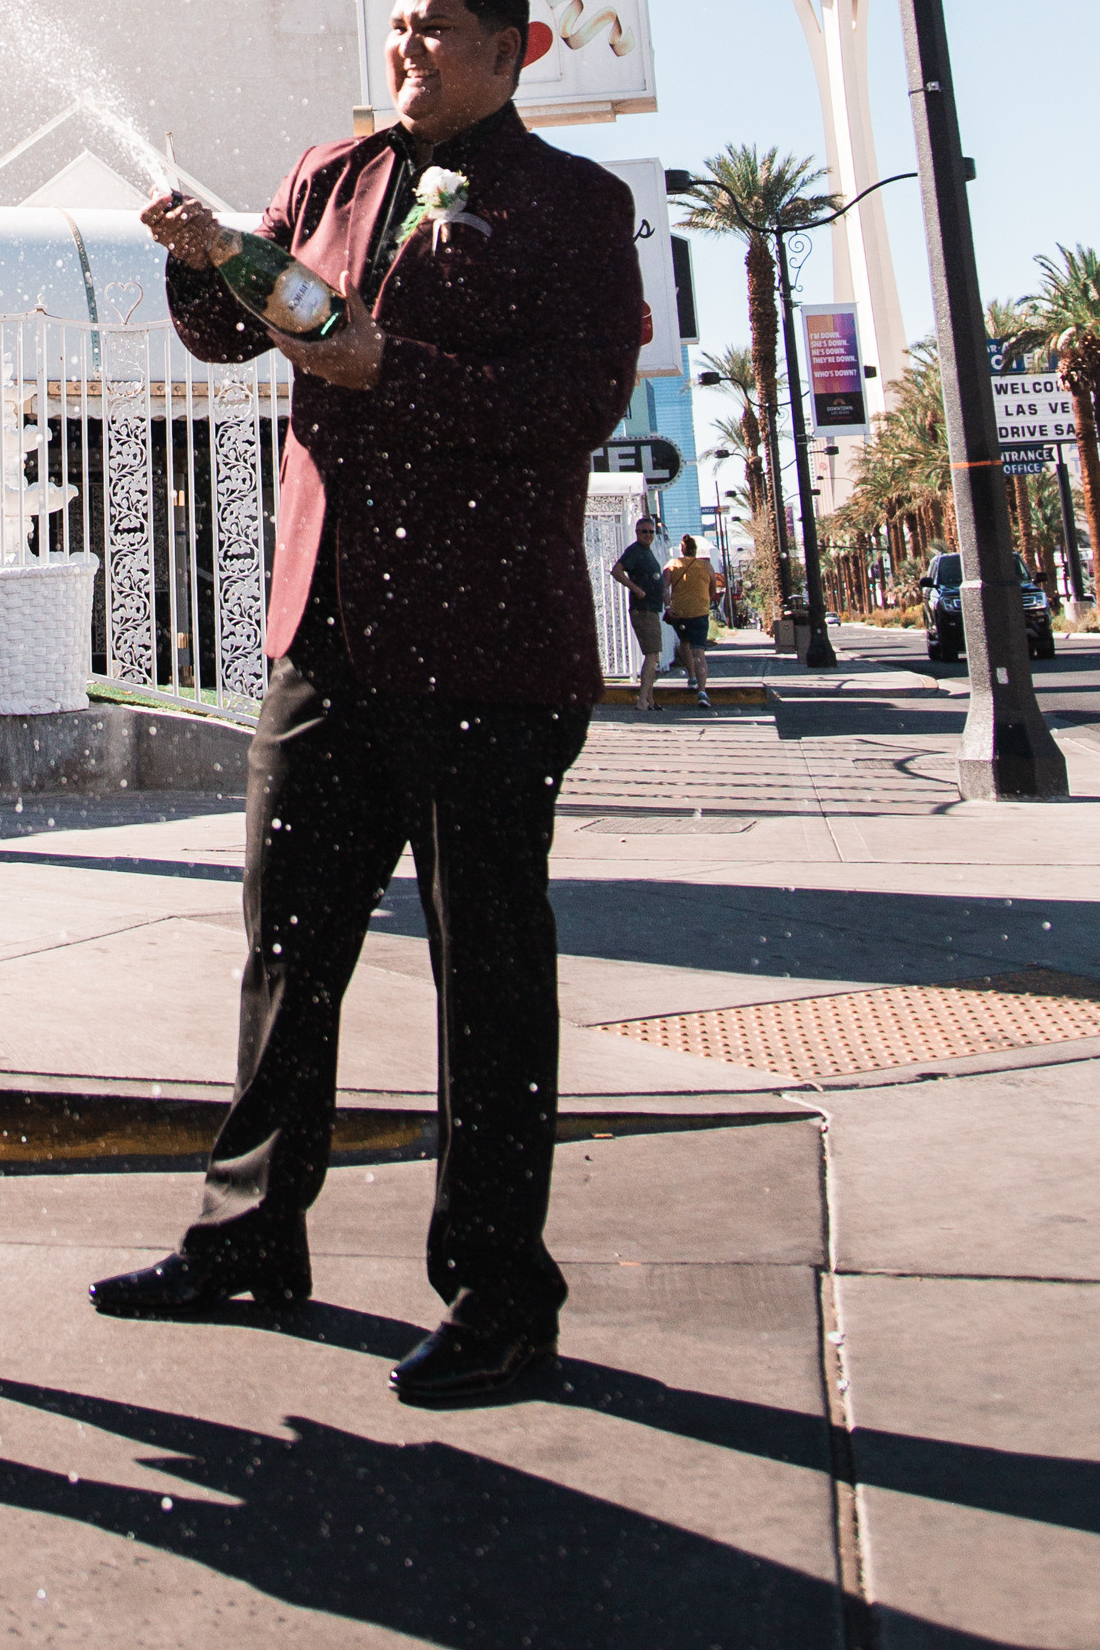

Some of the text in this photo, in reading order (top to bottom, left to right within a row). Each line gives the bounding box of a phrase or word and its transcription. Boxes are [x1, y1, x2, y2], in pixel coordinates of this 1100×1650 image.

[821, 331, 842, 339] DOWN.
[811, 339, 849, 348] SHE'S DOWN.
[812, 347, 847, 356] HE'S DOWN.
[813, 356, 835, 364] THEY'RE
[814, 369, 857, 378] WHO'S DOWN?
[1004, 401, 1074, 417] LAS VE
[998, 424, 1049, 439] DRIVE
[1003, 462, 1041, 473] OFFICE
